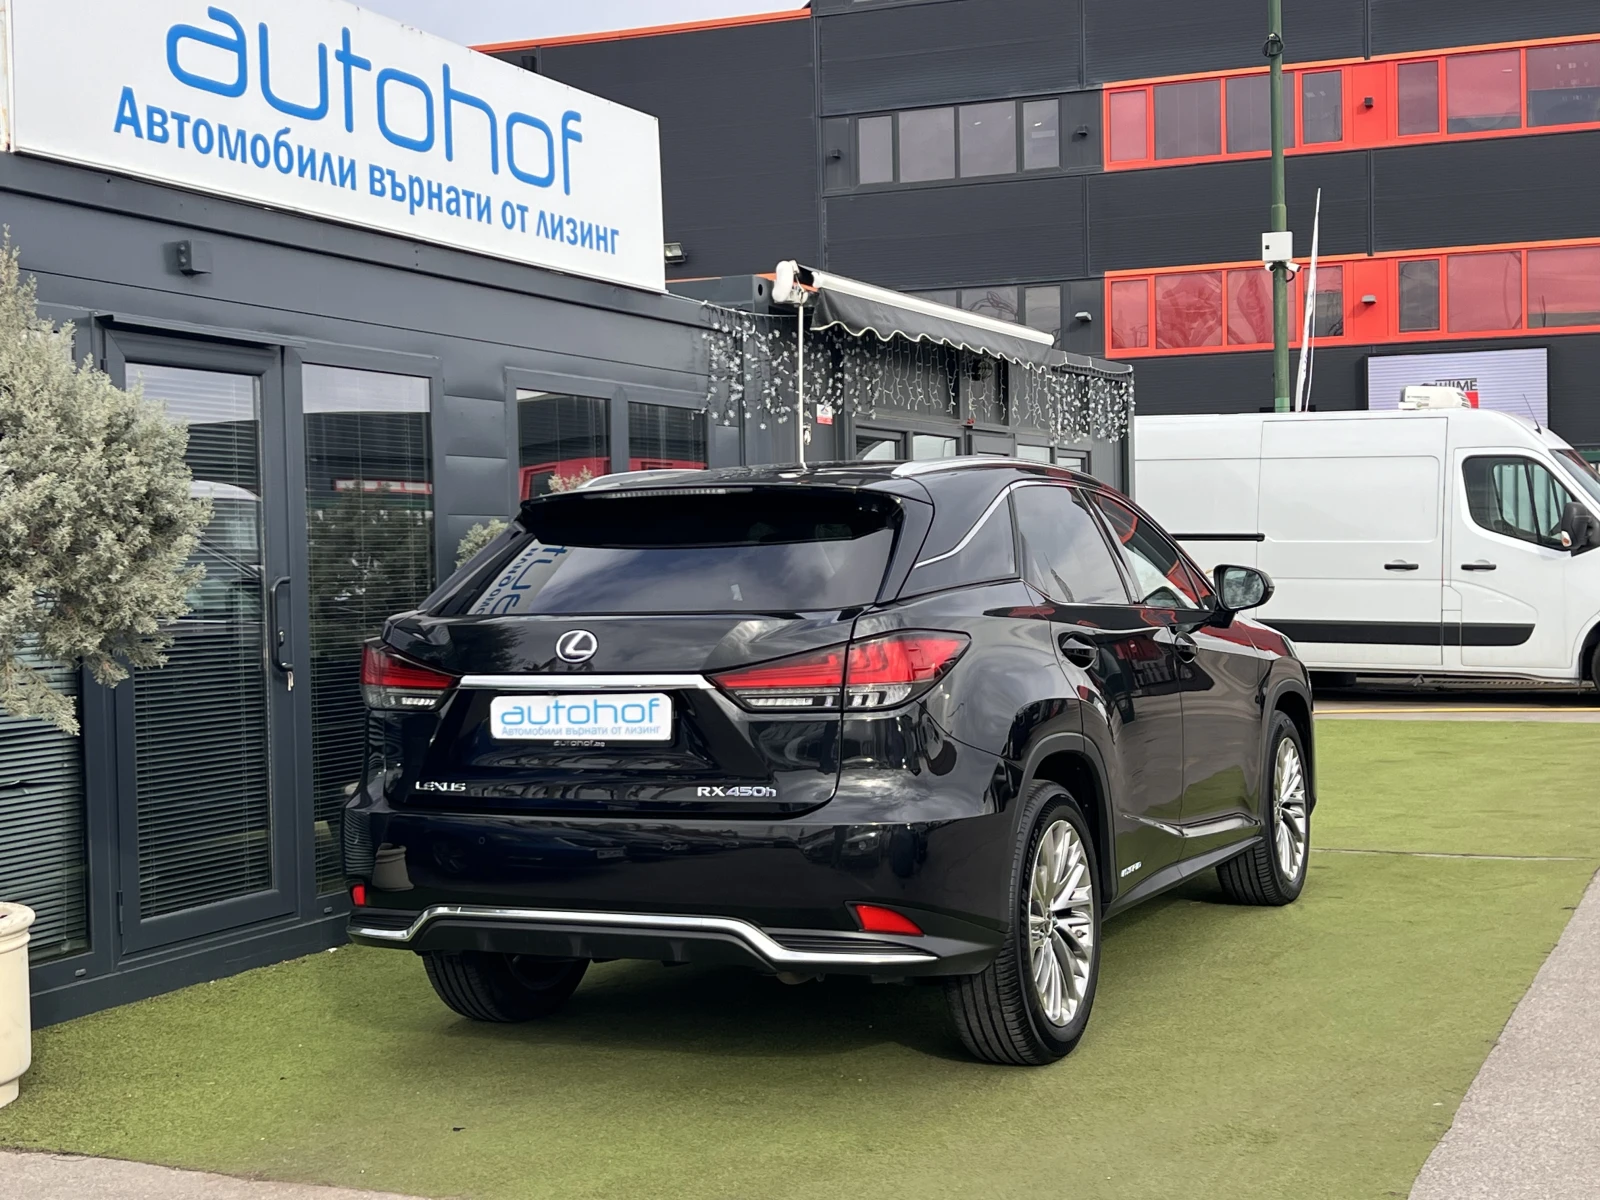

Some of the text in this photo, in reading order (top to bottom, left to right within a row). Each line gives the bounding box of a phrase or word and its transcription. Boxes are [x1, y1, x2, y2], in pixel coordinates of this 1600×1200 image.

[165, 5, 584, 196] autohof
[113, 85, 620, 255] Автомобили върнати от лизинг
[501, 697, 660, 725] autohof
[502, 725, 661, 736] Автомобили върнати от лизинг
[415, 781, 466, 792] LEXUS
